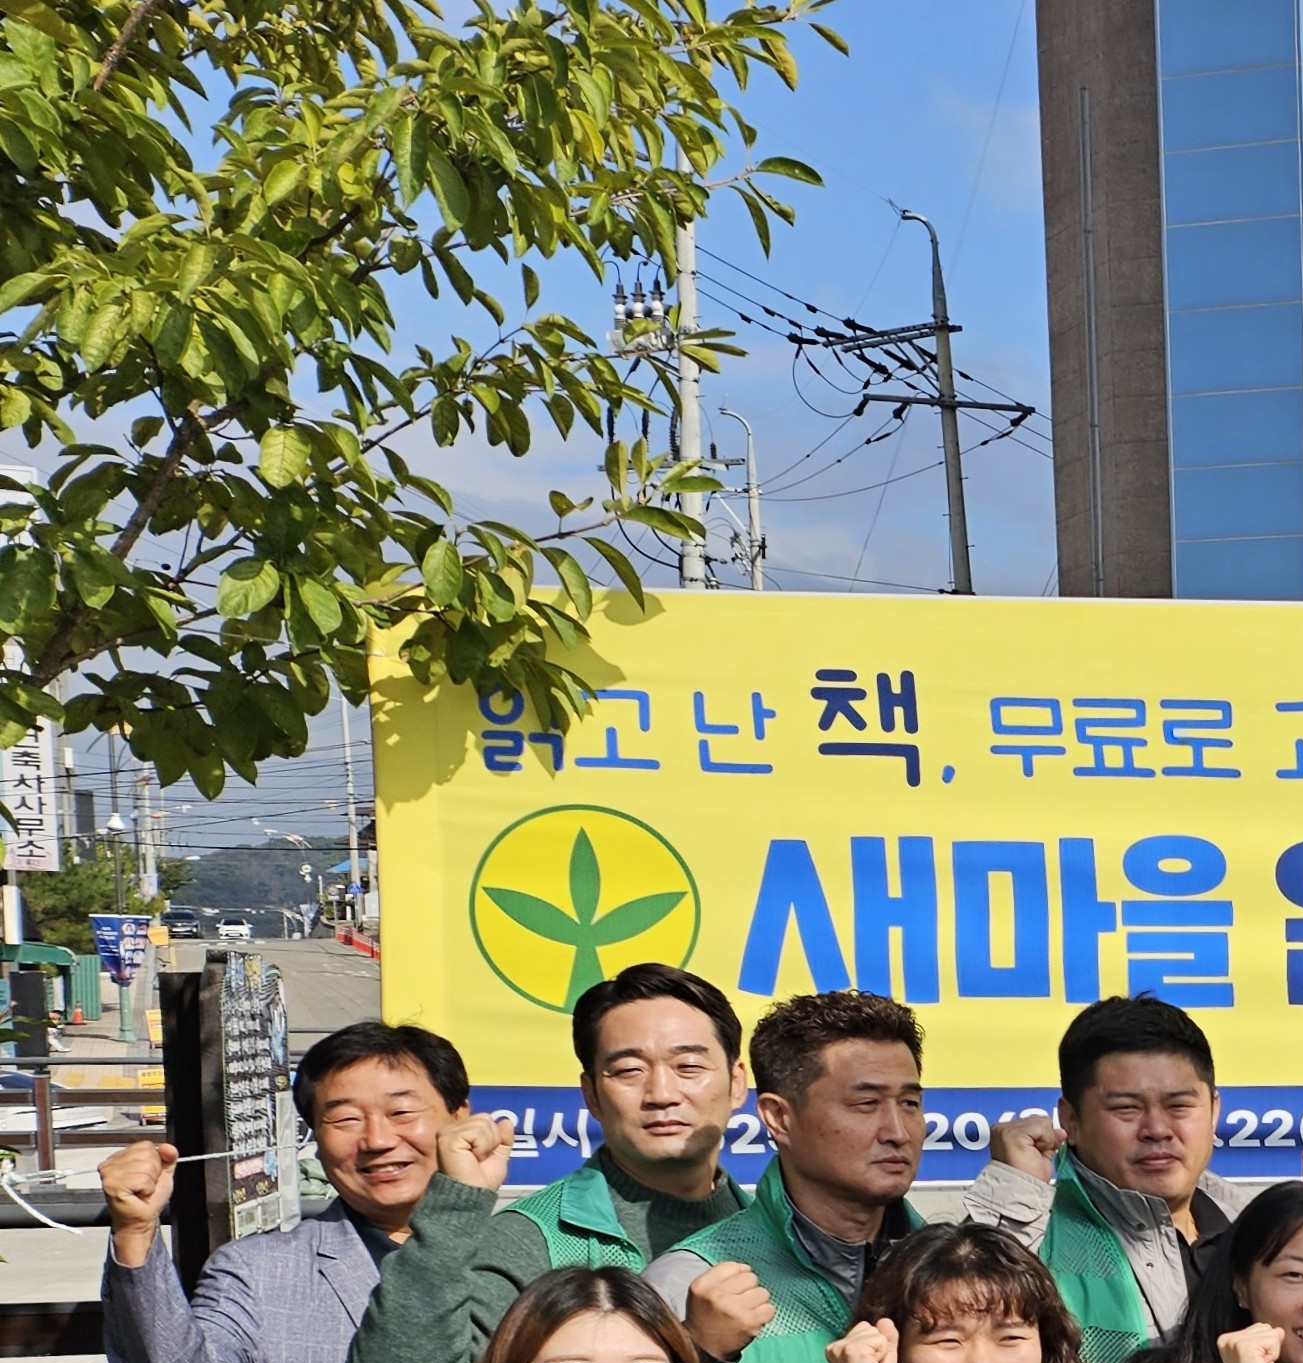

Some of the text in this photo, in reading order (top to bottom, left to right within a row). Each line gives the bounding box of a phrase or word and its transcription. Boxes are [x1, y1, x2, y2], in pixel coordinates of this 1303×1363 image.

[478, 683, 661, 773] 읽고
[694, 691, 777, 774] 난
[810, 668, 957, 788] 책,
[988, 696, 1242, 779] 무료로
[737, 835, 1235, 1007] 새마을
